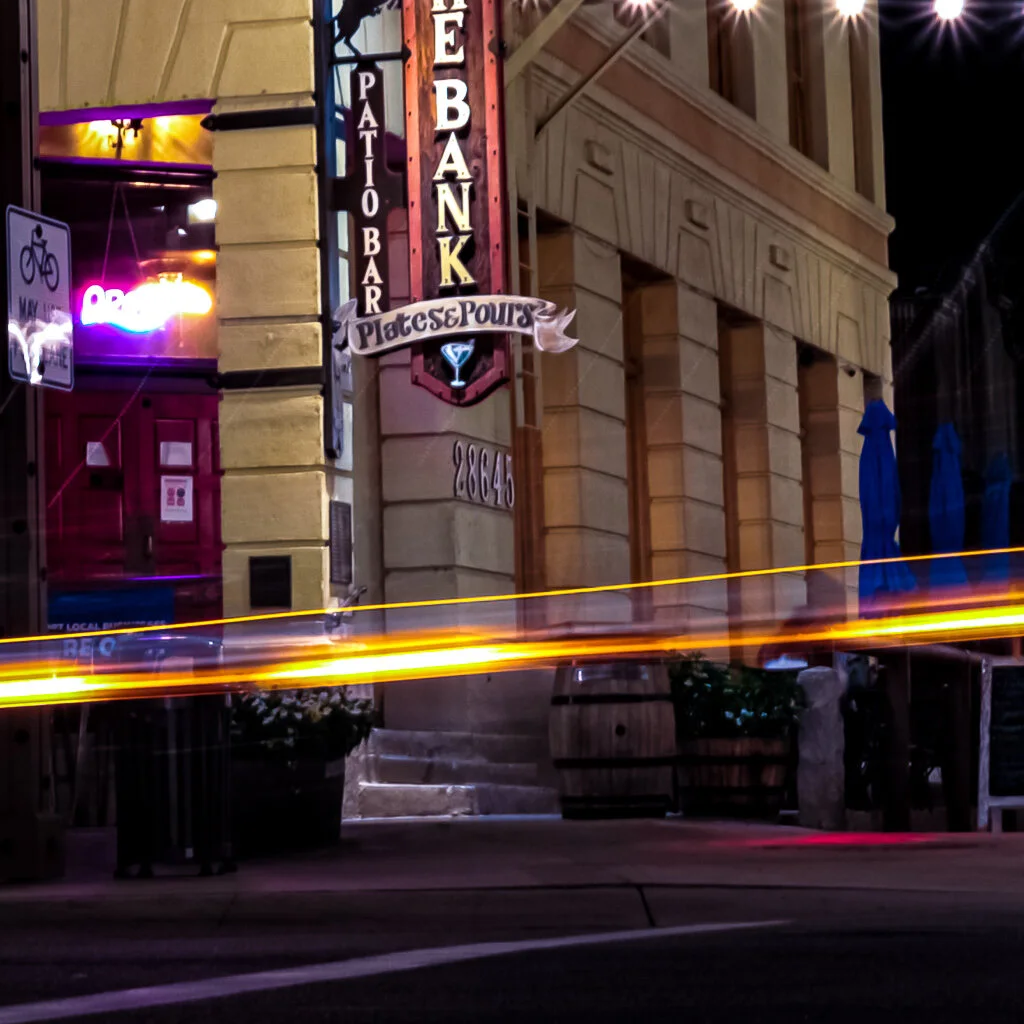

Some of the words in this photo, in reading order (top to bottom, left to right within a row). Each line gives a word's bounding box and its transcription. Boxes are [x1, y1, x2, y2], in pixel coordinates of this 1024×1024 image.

[357, 72, 380, 218] PATIO
[432, 78, 478, 287] BANK
[361, 226, 384, 315] BAR
[453, 440, 515, 508] 28645
[66, 622, 101, 632] LOCAL
